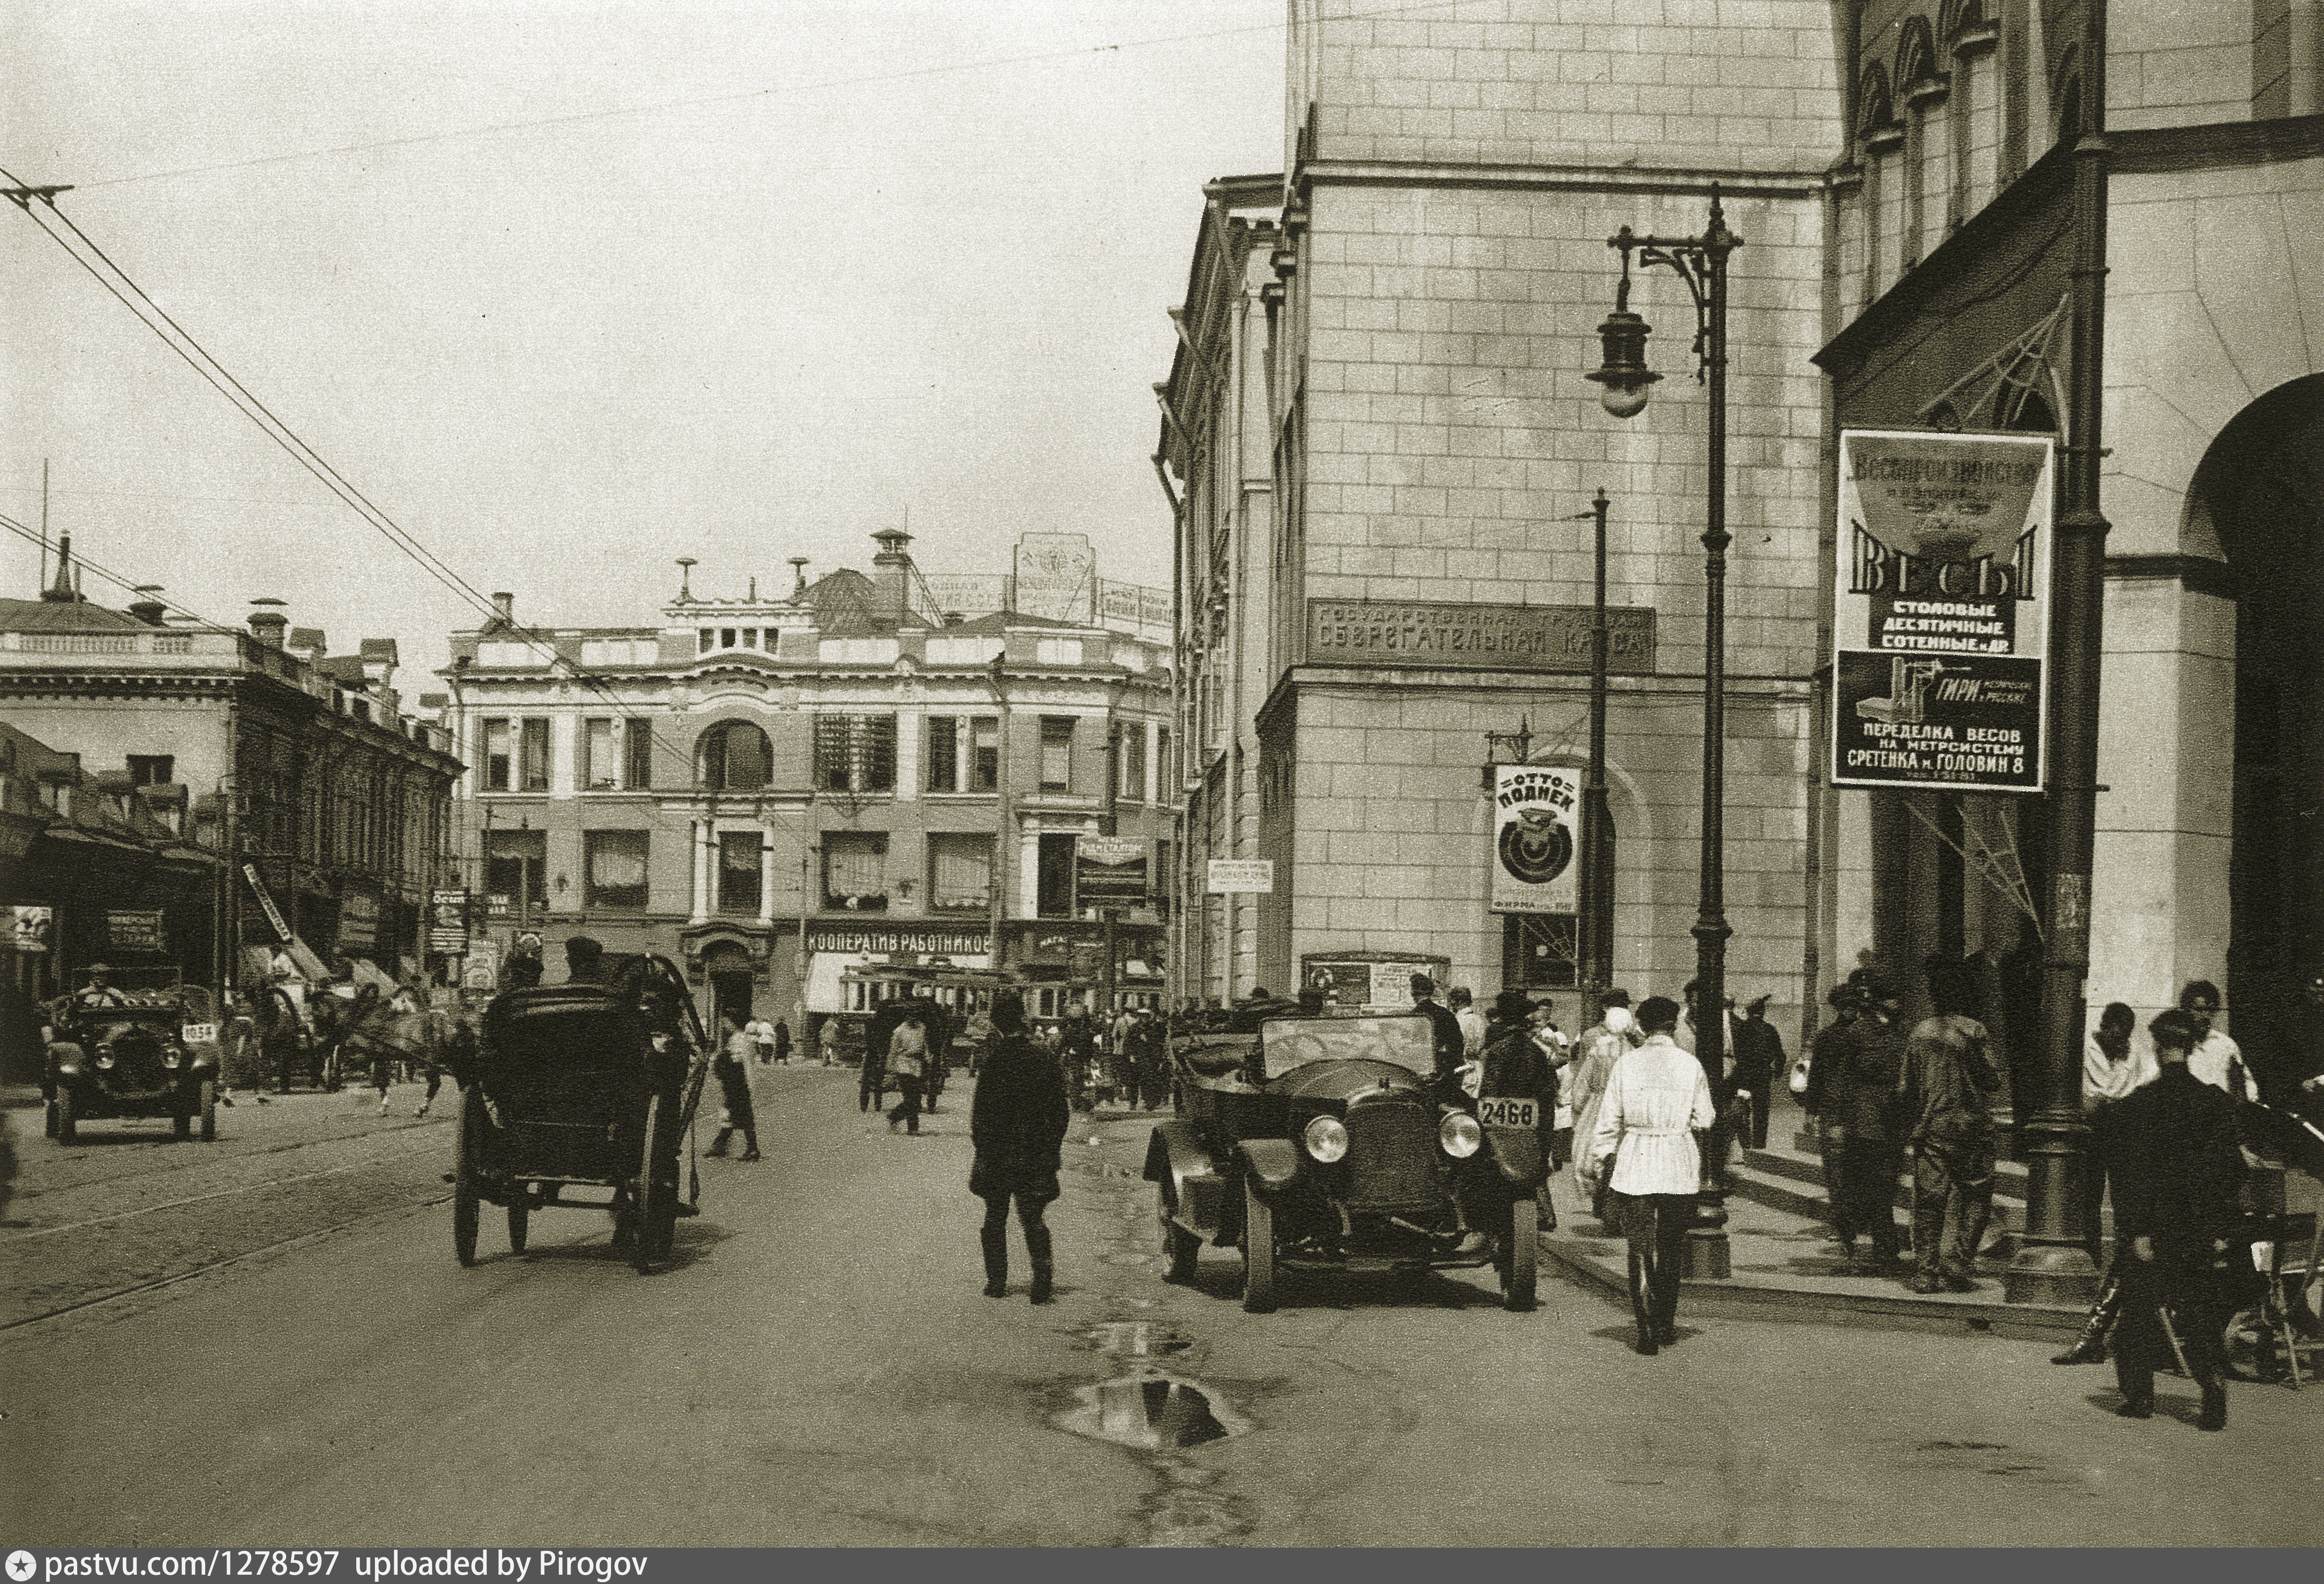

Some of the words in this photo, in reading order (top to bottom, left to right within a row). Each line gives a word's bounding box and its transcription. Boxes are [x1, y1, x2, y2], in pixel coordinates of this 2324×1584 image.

[1849, 518, 2037, 601] ВЕСЫ
[1319, 608, 1521, 626] ГОСУДАРСТВЕННАЯ
[1894, 601, 1996, 617] СТОЛОВЫЕ
[1883, 617, 2004, 635] ДЕСЯТИЧНЫЕ
[1319, 625, 1545, 653] СБЕРЕГАТЕЛЬНАЯ
[1564, 629, 1644, 654] КАСА
[1882, 634, 1978, 651] СОТЕННЫЕ
[1935, 678, 1981, 701] ГИРИ
[1864, 722, 1954, 740] ПЕРЕДЕЛКА
[1966, 728, 2021, 743] ВЕСОВ
[1880, 739, 1897, 749] НА
[1907, 741, 2024, 755] МЕТРСИСТЕМУ
[1847, 749, 1918, 769] СРЕТЕНКА
[1937, 754, 2008, 773] ГОЛОВИН
[2013, 757, 2024, 774] 8
[1514, 773, 1563, 788] ОТТО
[809, 933, 897, 951] КООПЕРАТИВ
[901, 934, 991, 952] РАБОТНИКОВ
[1482, 1103, 1532, 1126] 2468
